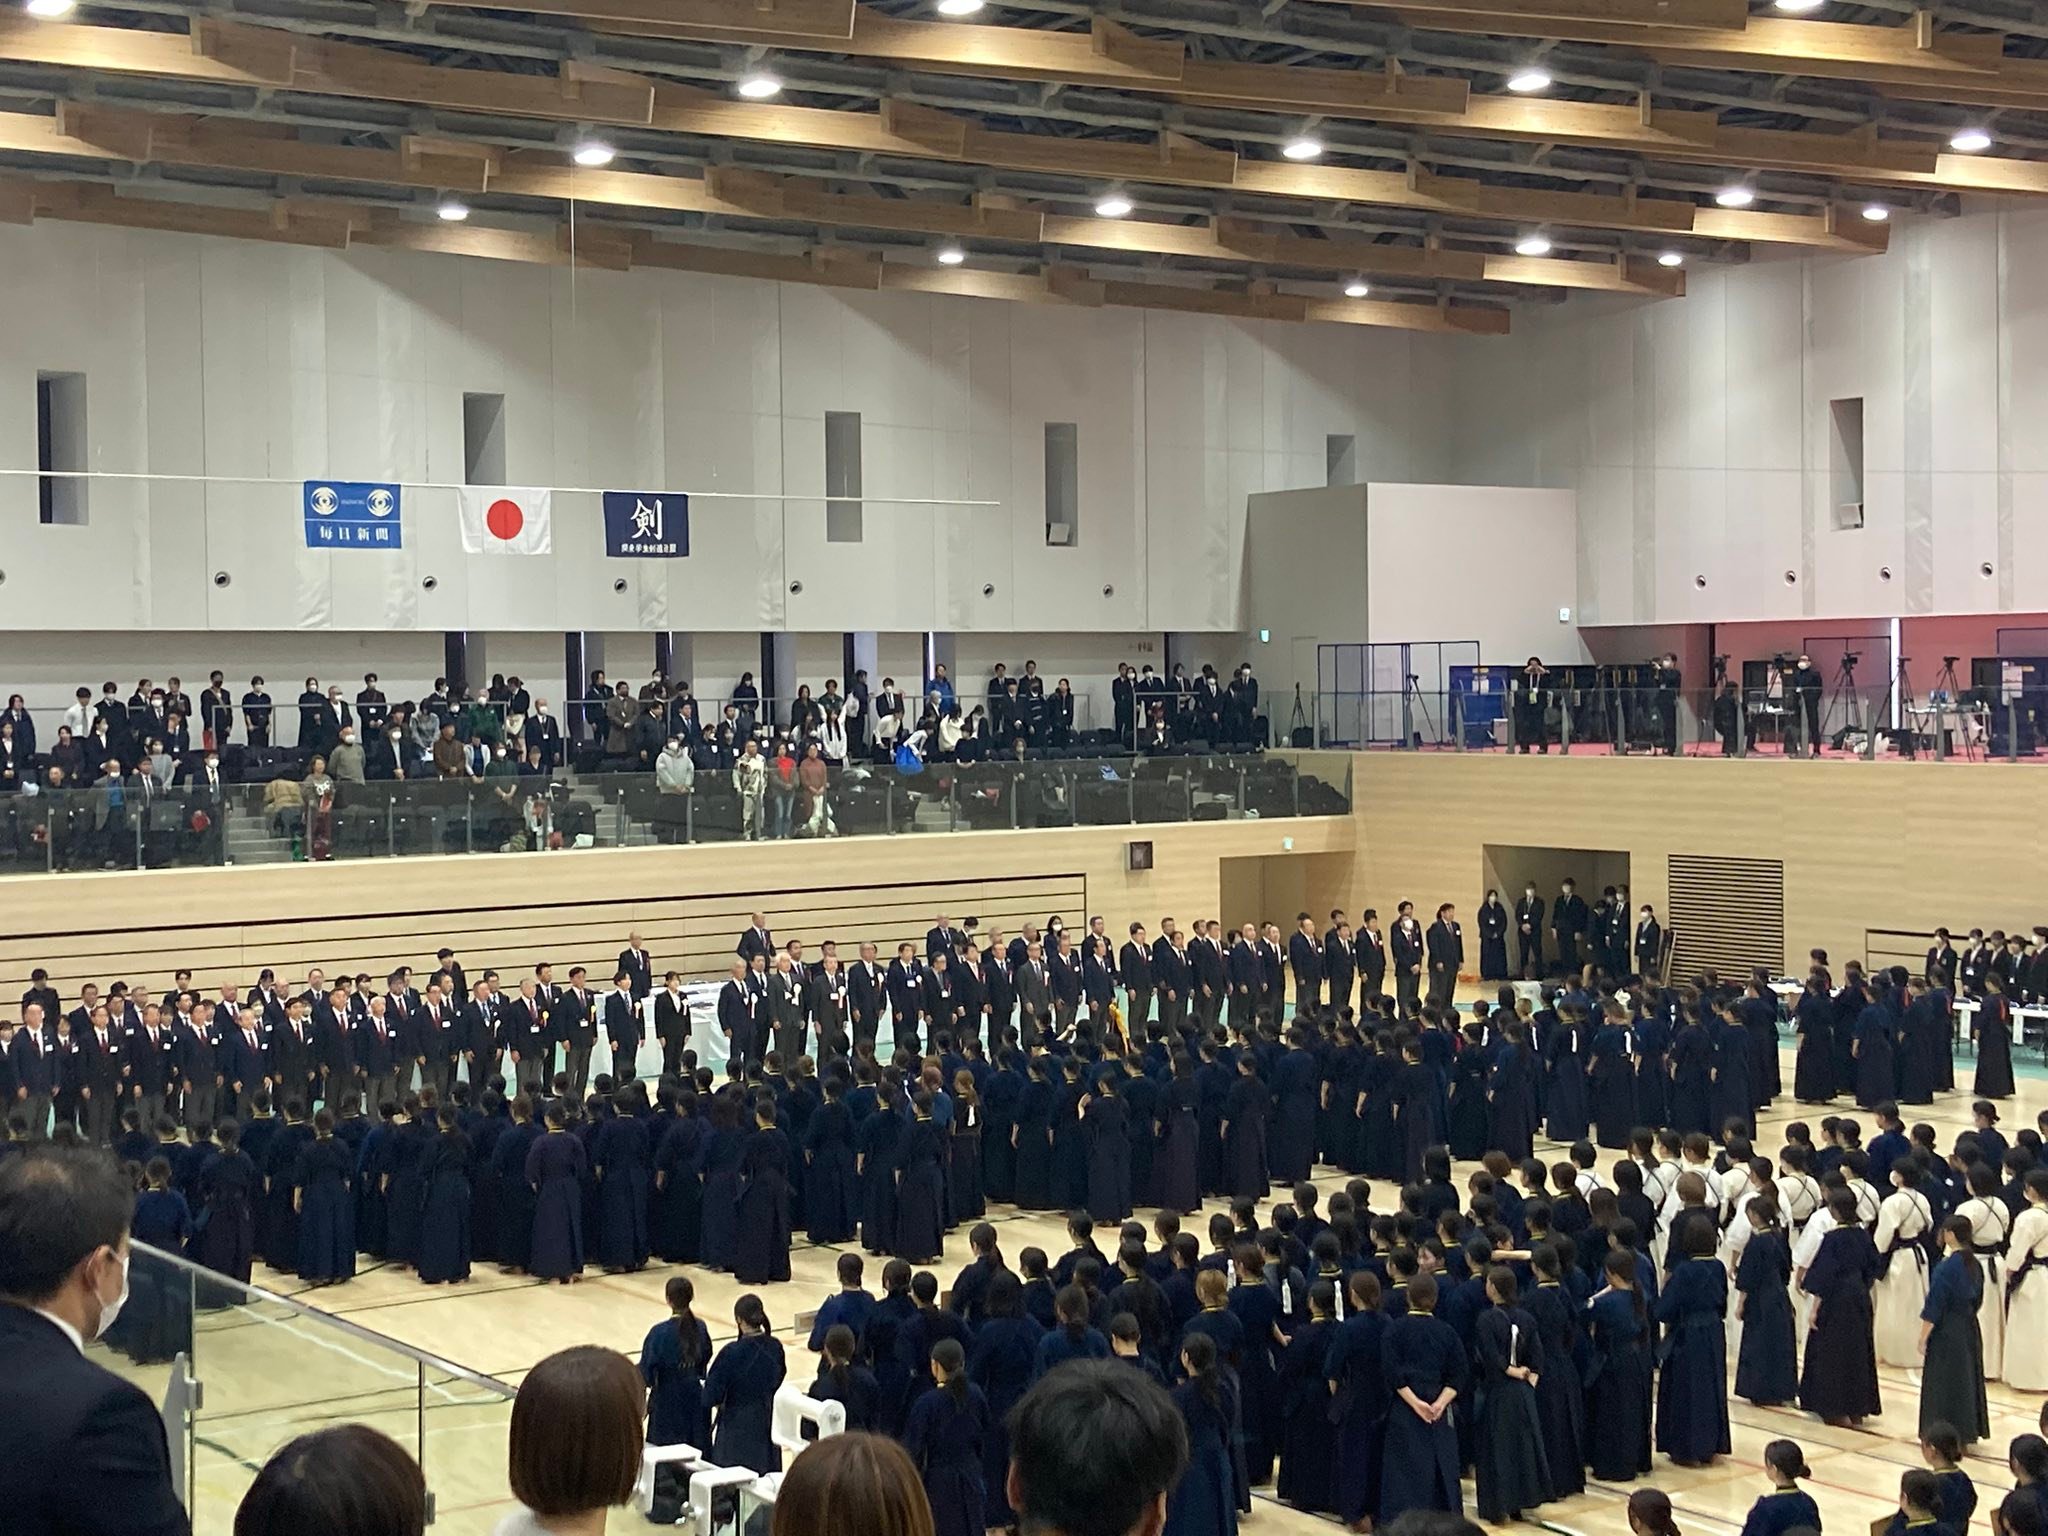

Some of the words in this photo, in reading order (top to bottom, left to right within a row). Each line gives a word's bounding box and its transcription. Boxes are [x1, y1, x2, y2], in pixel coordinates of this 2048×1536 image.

[320, 524, 389, 541] 毎日新聞
[630, 498, 663, 540] 剣
